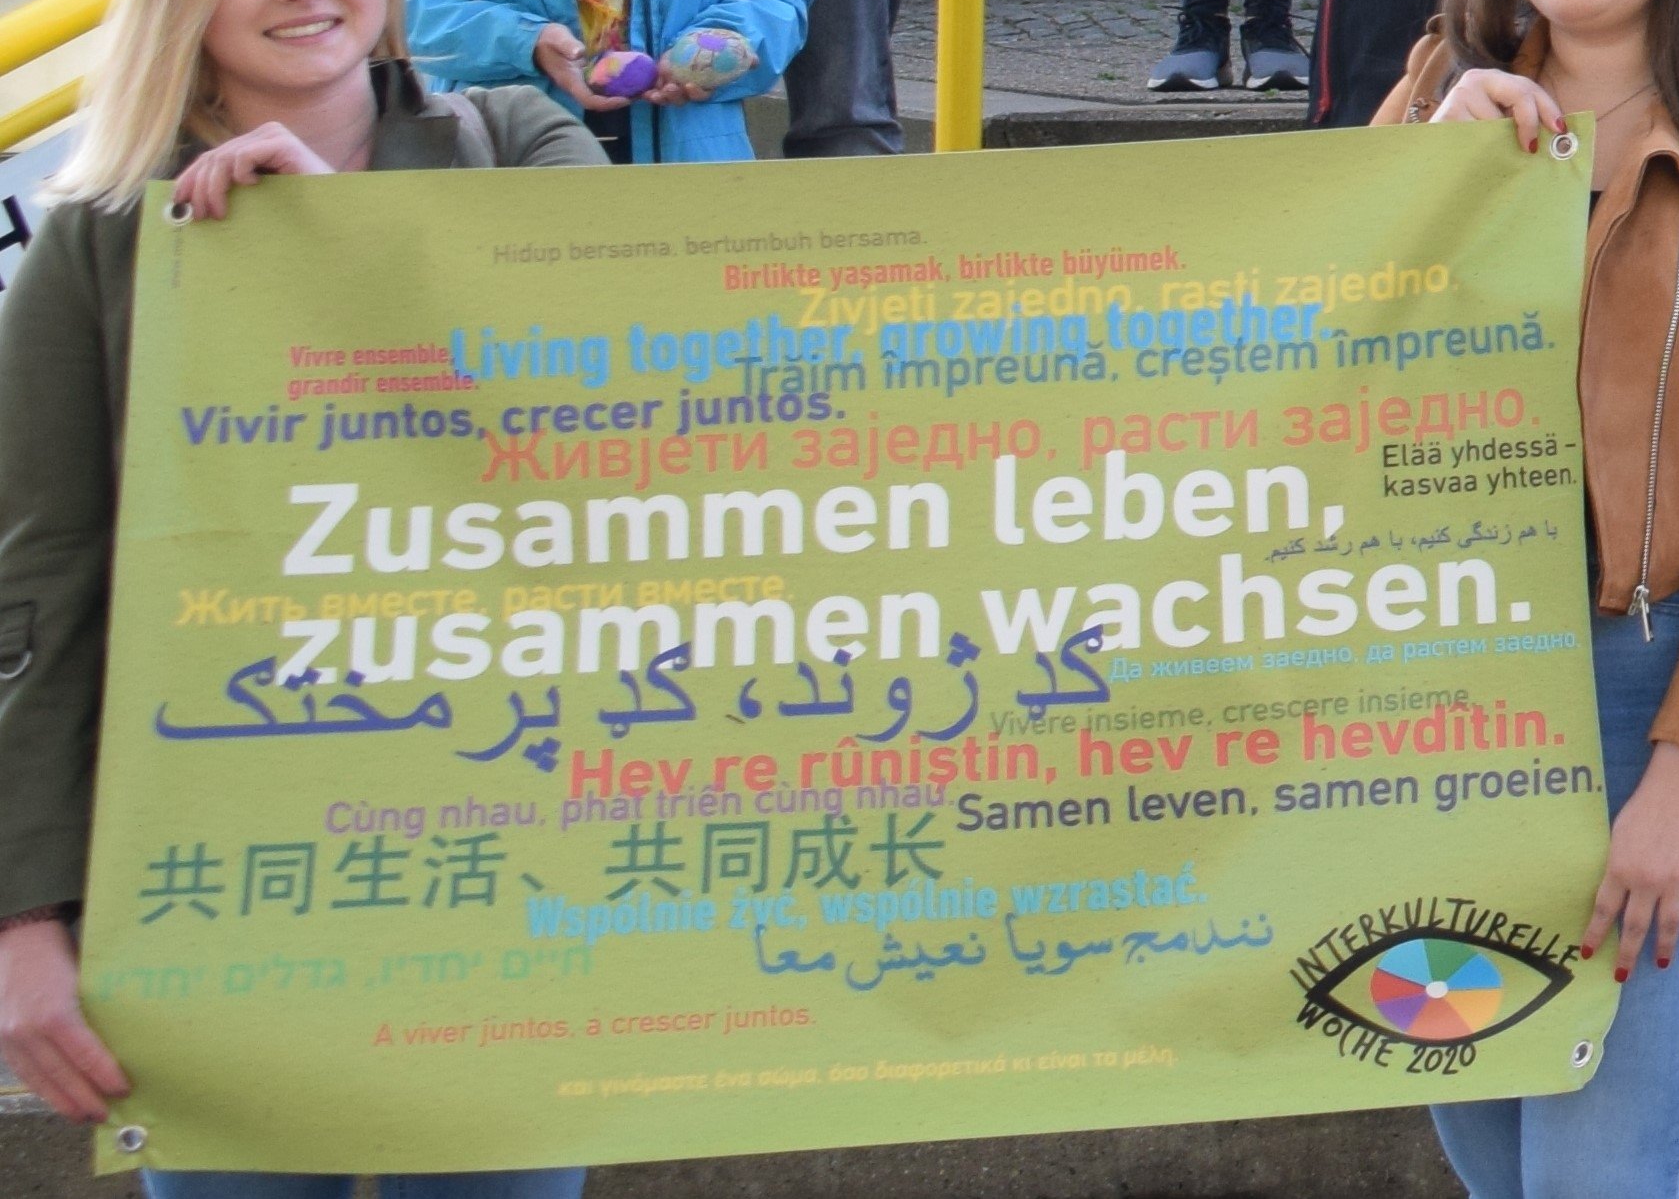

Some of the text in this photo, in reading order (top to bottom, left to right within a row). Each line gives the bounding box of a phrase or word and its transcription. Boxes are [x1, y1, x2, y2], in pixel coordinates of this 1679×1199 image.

[493, 242, 561, 267] Hidup
[685, 231, 815, 256] bertumbuh
[818, 228, 927, 251] bersama.
[723, 245, 1187, 293] Birlikte yaşamak, birlikte büyümek.
[1161, 268, 1260, 312] rasti
[290, 346, 345, 367] Vivre
[450, 291, 1334, 389] Living together, growing together.
[735, 353, 866, 399] Trăim
[1335, 311, 1555, 372] împreună.
[287, 370, 479, 401] grandir ensemble.
[182, 388, 846, 450] Vivir juntos, crecer juntos.
[481, 423, 769, 491] Живјети
[1082, 407, 1259, 471] расти
[1282, 385, 1540, 453] заједно.
[1382, 443, 1442, 469] Elää
[1451, 435, 1557, 469] yhdessä
[1383, 463, 1577, 497] kasvaa yhteen.
[282, 449, 1345, 577] Zusammen leben,
[175, 589, 308, 627] Жить
[502, 581, 623, 621] расти
[275, 553, 1531, 687] zusammen wachsen.
[1109, 658, 1142, 683] Да
[1150, 654, 1253, 678] живеем
[1366, 642, 1394, 664] да
[1403, 634, 1486, 662] растем
[990, 709, 1077, 737] Vivere
[1222, 692, 1349, 726] crescere
[570, 749, 694, 800] Hev
[713, 751, 778, 792] re
[1078, 727, 1193, 777] hev
[1214, 726, 1280, 768] re
[1303, 699, 1566, 761] hevdîtin.
[956, 757, 1602, 833] Samen leven, samen groeien.
[324, 800, 426, 840] Cùng
[525, 888, 717, 945] Wspólnie
[821, 875, 998, 930] wspólnie
[1010, 859, 1208, 917] wzrastać.
[1290, 896, 1582, 993] INTERKULTURELLE
[373, 1023, 394, 1047] A
[404, 1020, 472, 1046] viver
[610, 1008, 716, 1035] crescer
[723, 1003, 816, 1035] juntos.
[1296, 1000, 1477, 1076] WOCHE 2020
